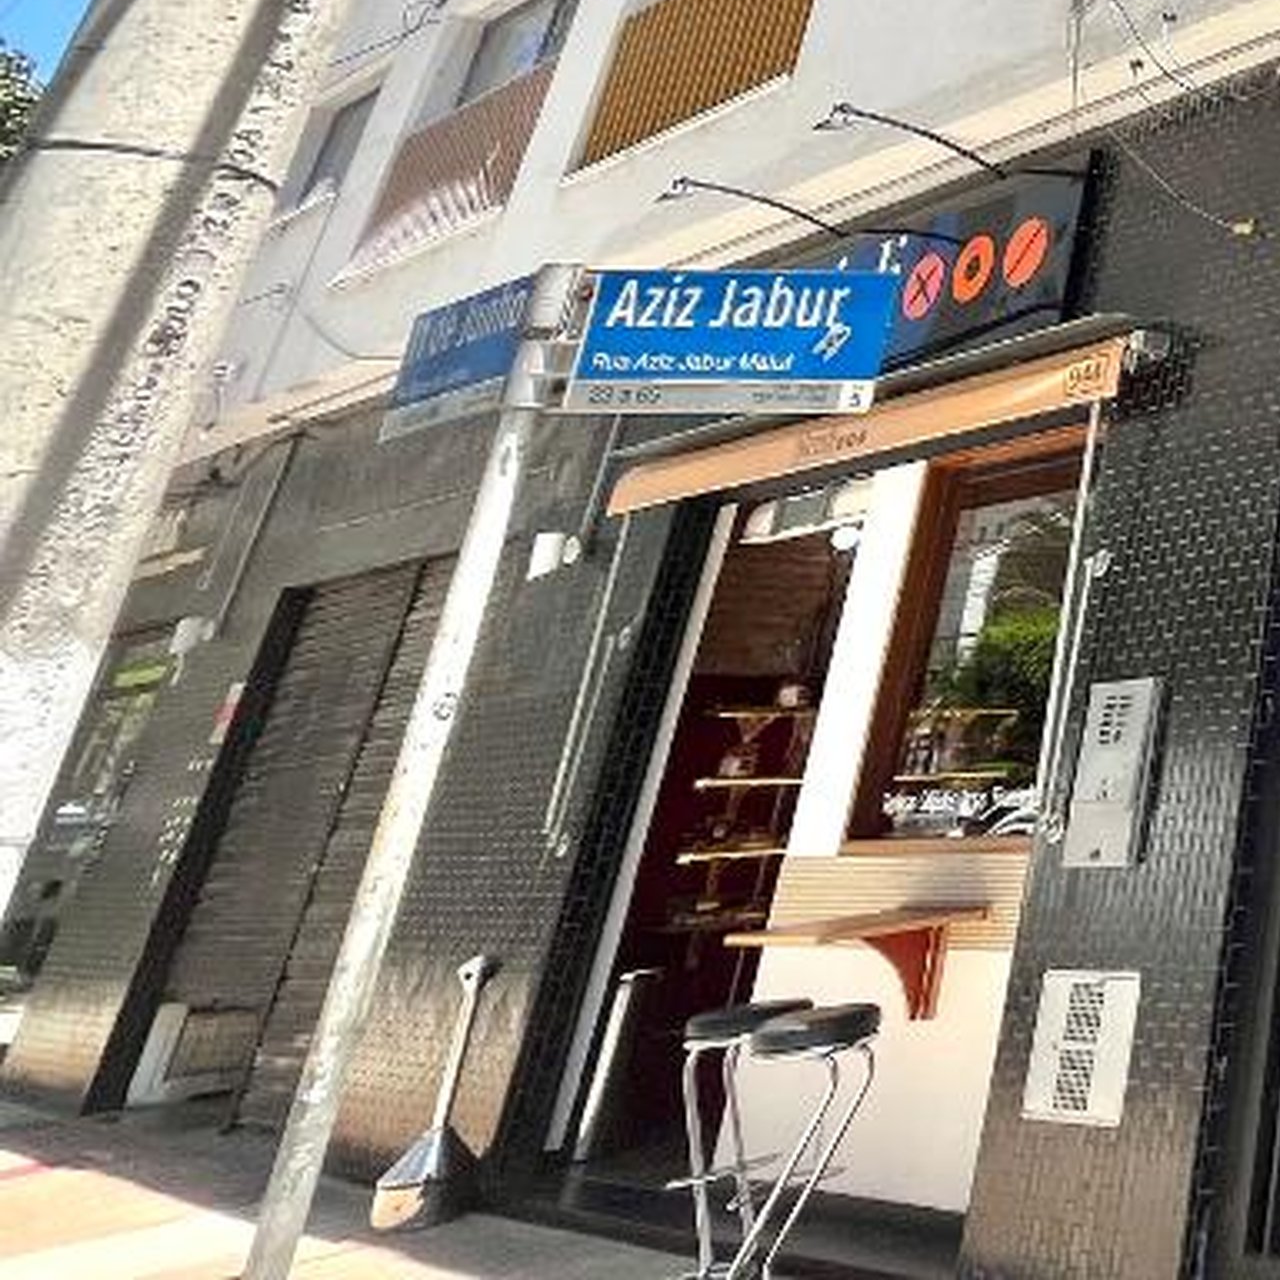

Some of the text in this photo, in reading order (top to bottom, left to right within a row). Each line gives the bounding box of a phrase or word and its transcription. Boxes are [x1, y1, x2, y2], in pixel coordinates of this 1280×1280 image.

[605, 276, 852, 330] Aziz Jabur
[592, 352, 631, 371] Rua
[633, 352, 676, 371] Aziz
[678, 352, 735, 371] Jabur
